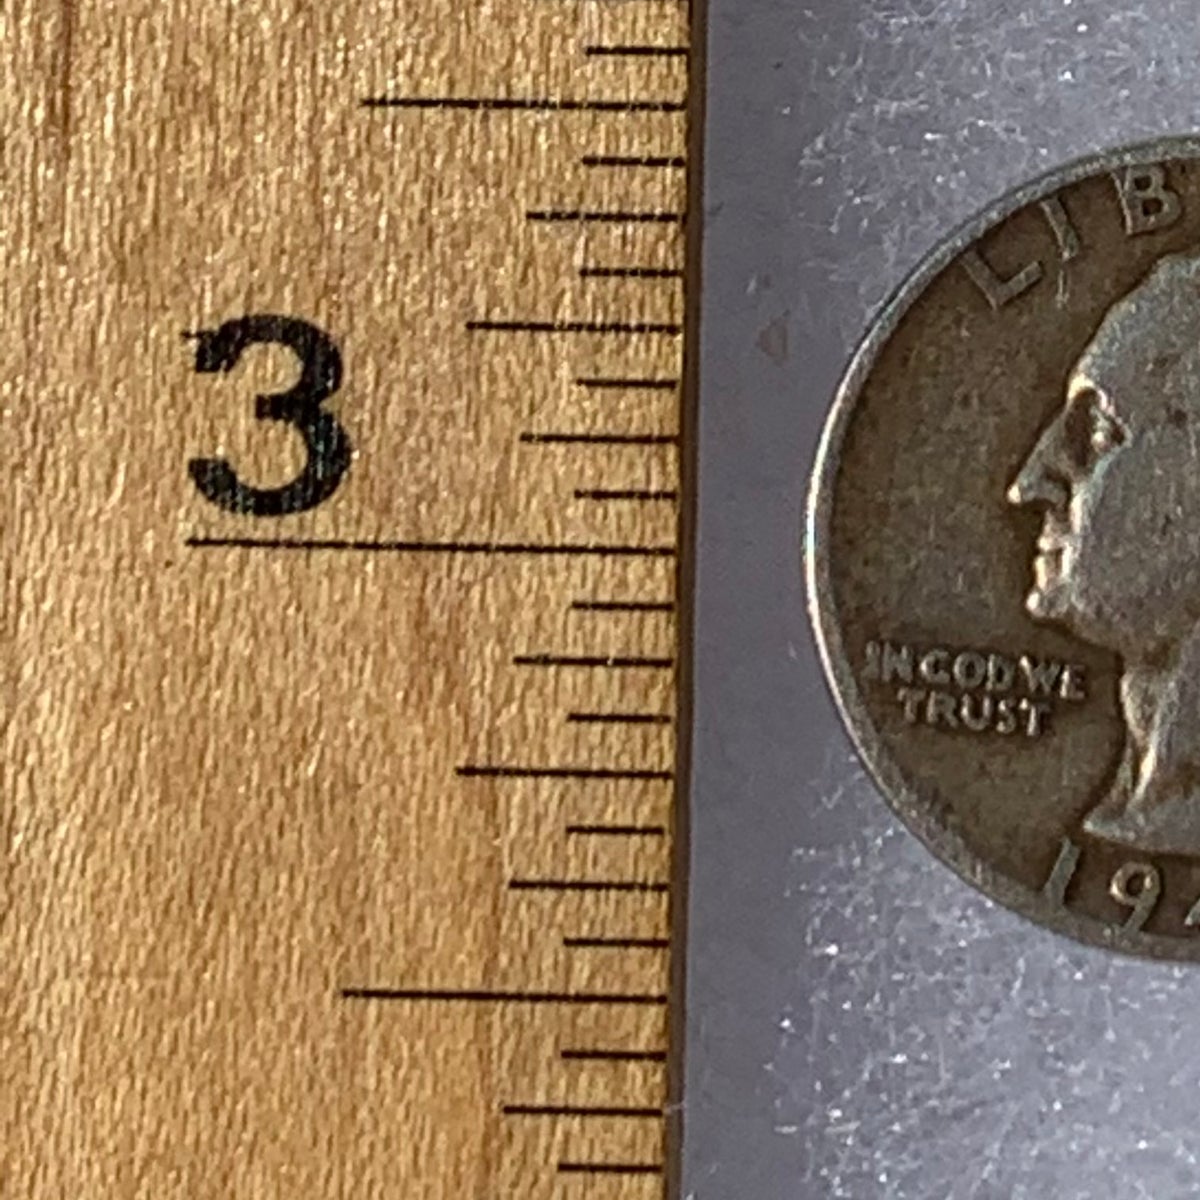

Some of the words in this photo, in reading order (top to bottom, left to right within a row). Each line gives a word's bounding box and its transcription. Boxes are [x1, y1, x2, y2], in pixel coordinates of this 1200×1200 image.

[187, 313, 353, 517] 3
[862, 640, 913, 683] IN
[919, 649, 1016, 691] GOD
[1019, 655, 1086, 699] WE
[897, 687, 1050, 737] TRUST
